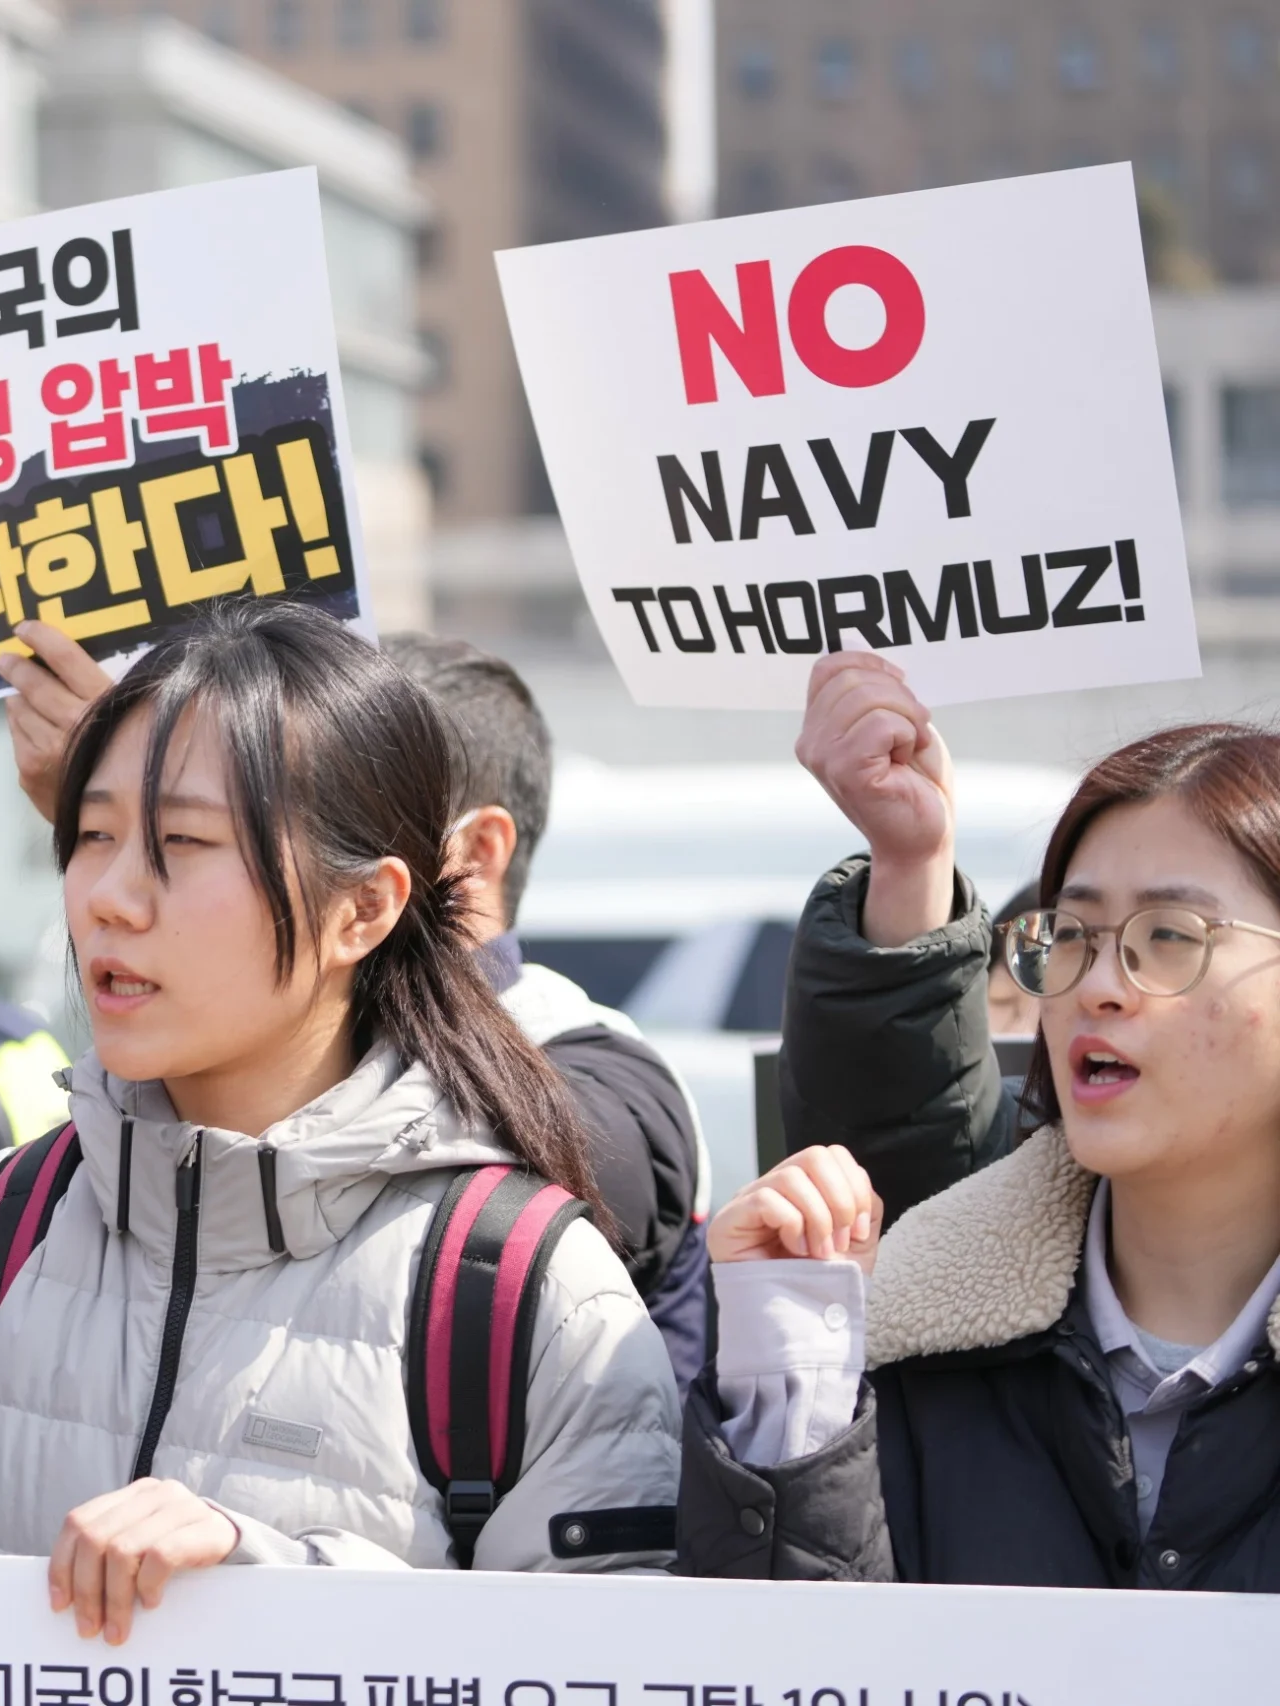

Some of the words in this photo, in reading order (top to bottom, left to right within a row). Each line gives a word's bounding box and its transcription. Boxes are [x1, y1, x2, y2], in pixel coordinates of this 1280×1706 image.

[668, 245, 926, 405] NO
[40, 343, 233, 470] 압박
[656, 417, 997, 544] NAVY
[611, 586, 716, 653] TO
[713, 538, 1146, 655] HORMUZ!
